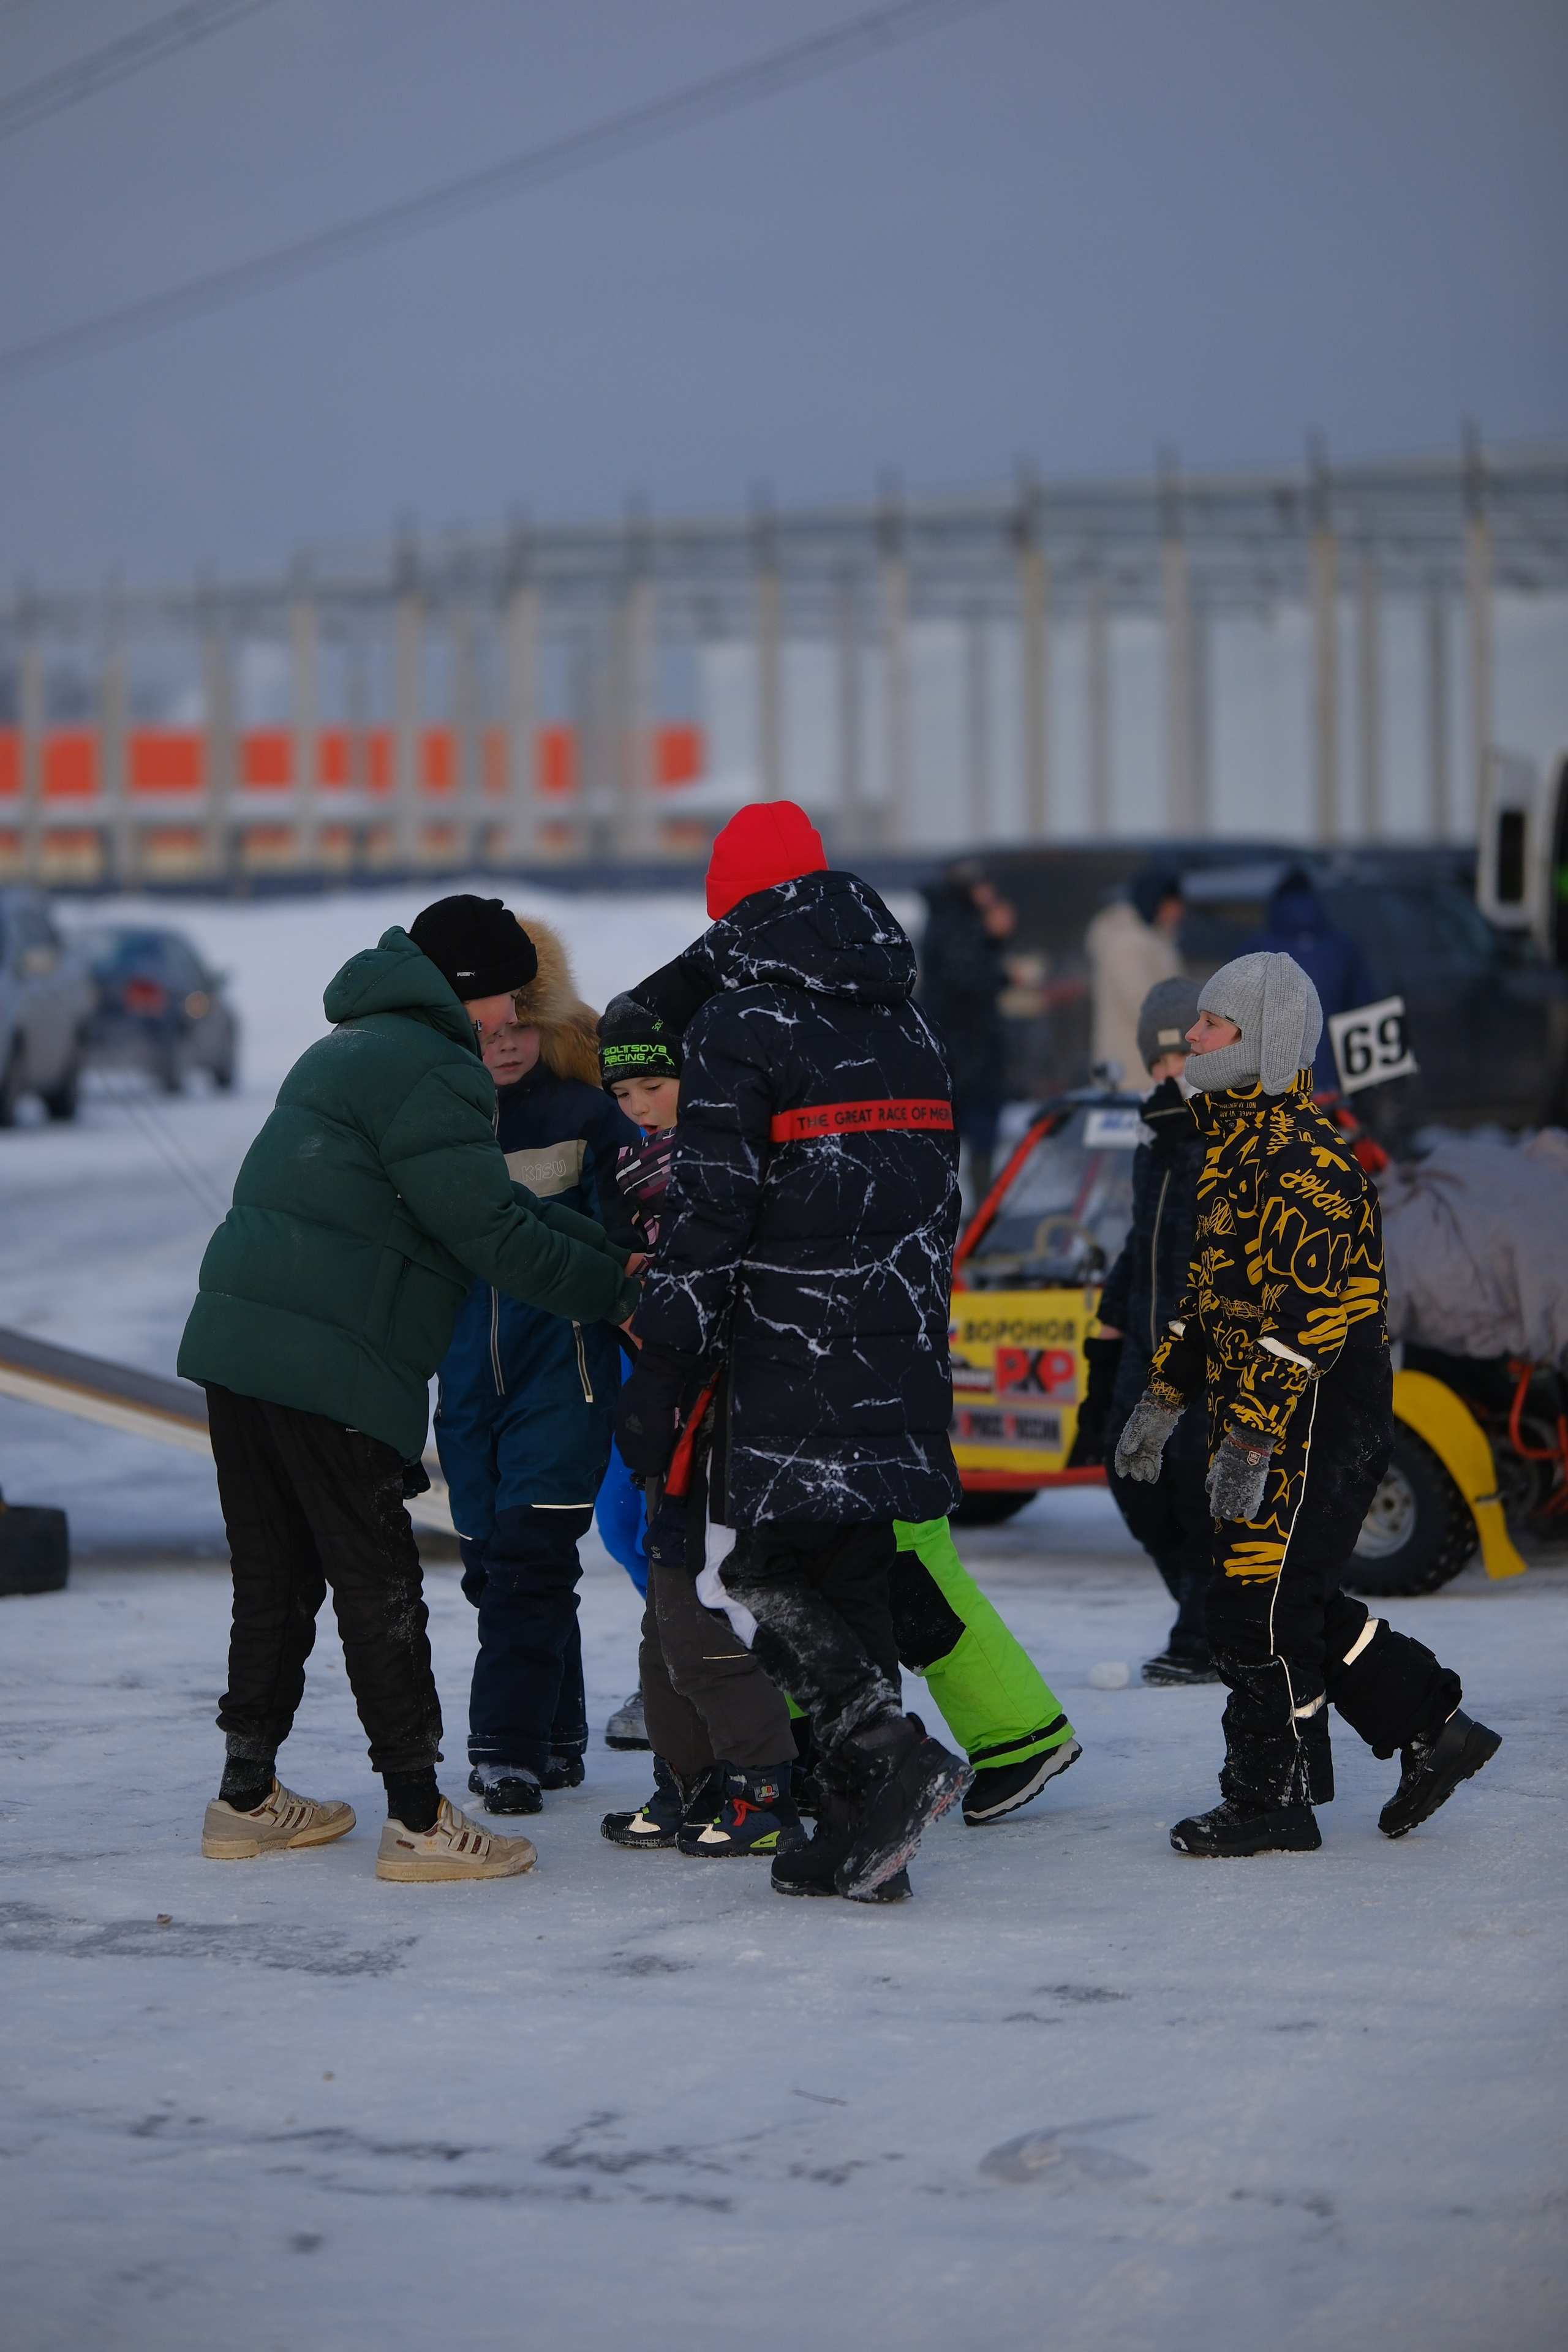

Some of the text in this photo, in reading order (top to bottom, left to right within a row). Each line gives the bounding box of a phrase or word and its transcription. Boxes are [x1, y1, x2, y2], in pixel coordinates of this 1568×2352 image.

[1344, 1017, 1409, 1076] 69
[797, 1114, 829, 1130] THE
[835, 1108, 872, 1125] GREAT
[878, 1107, 907, 1121] RACE
[911, 1106, 927, 1120] OF
